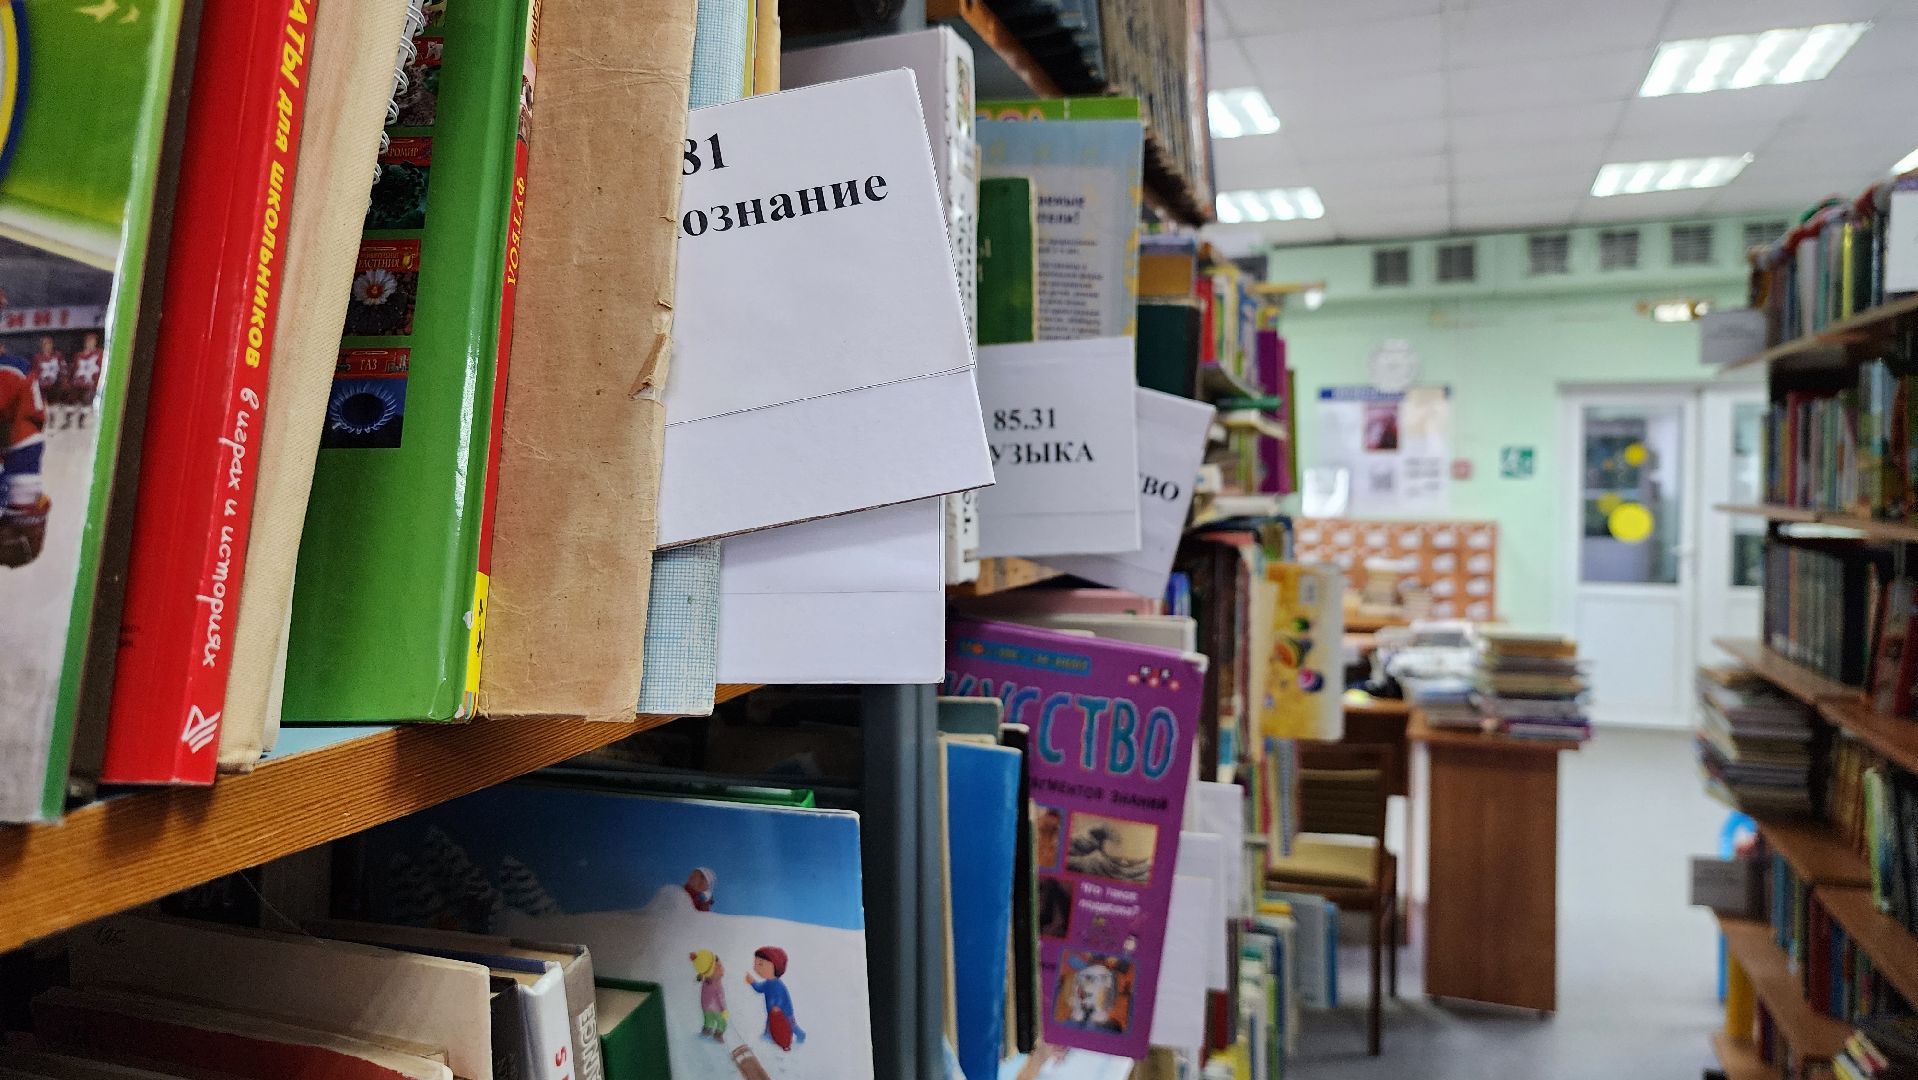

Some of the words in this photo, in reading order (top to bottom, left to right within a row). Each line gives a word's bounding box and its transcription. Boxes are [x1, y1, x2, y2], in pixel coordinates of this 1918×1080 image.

[280, 0, 311, 88] АТЫ
[507, 176, 526, 286] ФУТБОЛ
[679, 175, 889, 239] ознание
[360, 358, 378, 371] ГАЗ
[217, 410, 250, 491] играх
[993, 407, 1057, 431] 85.31
[223, 499, 238, 516] и
[1139, 471, 1180, 501] ВО
[195, 525, 234, 668] историях
[942, 670, 1180, 781] ССТВО
